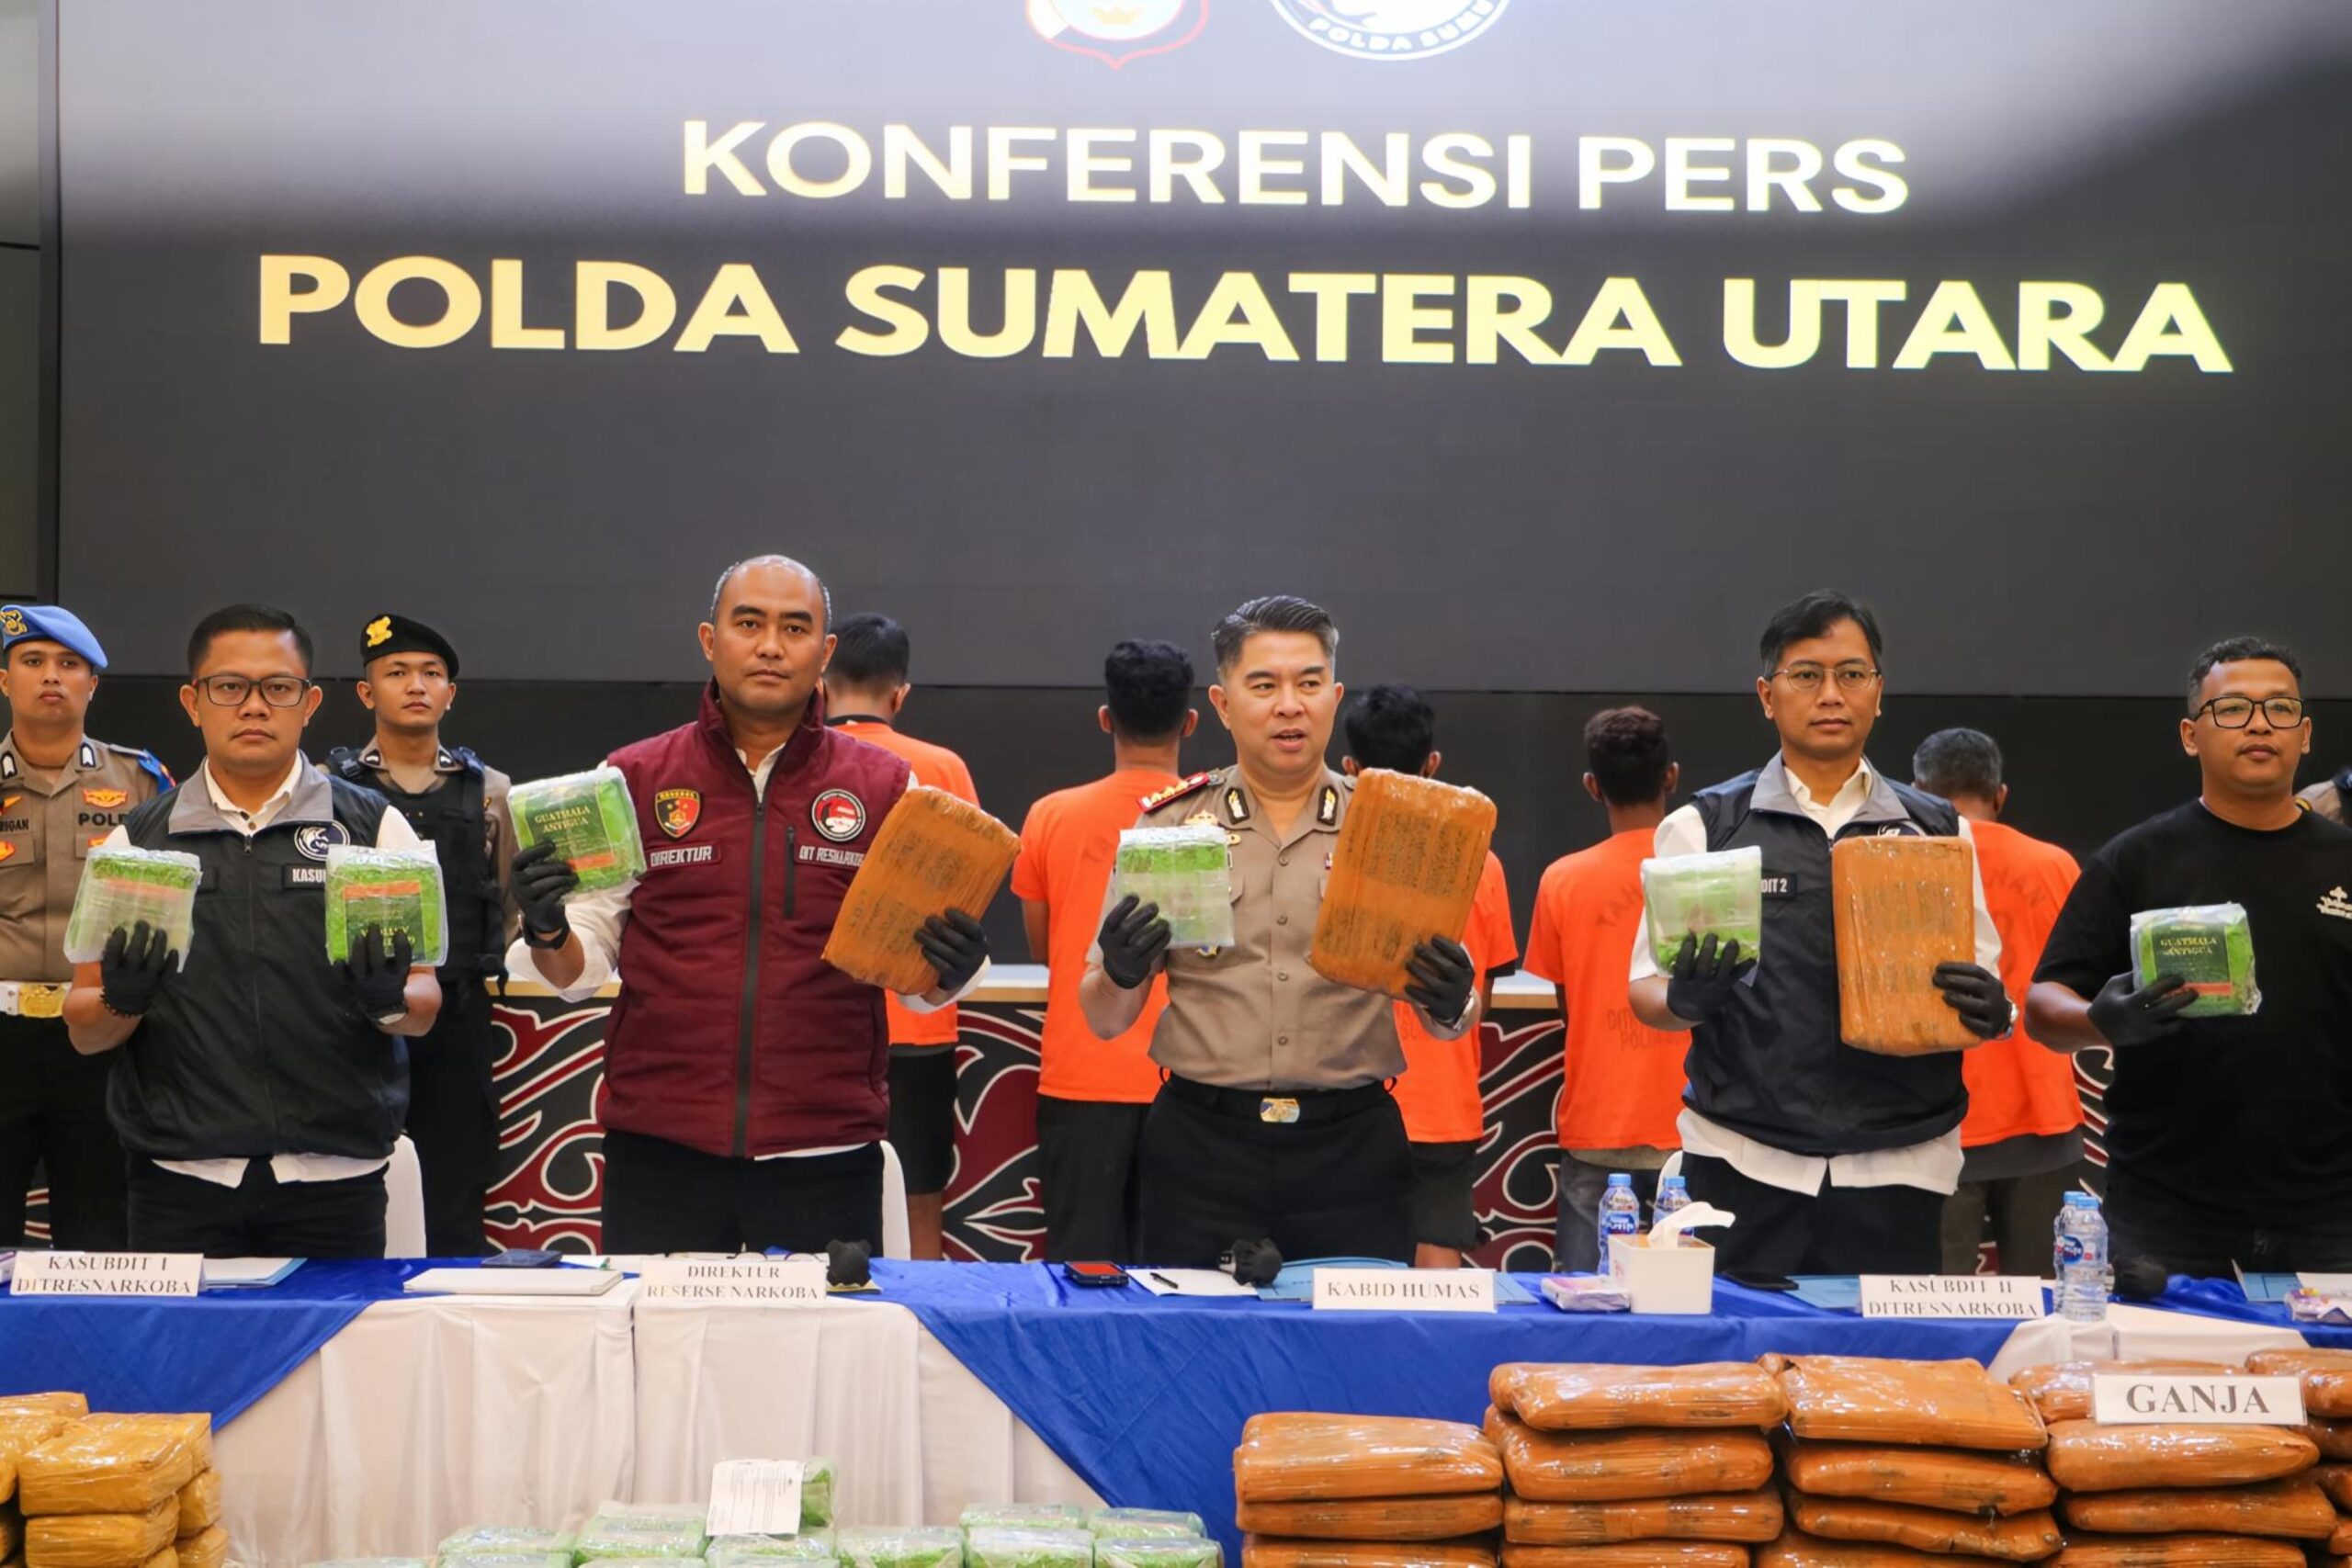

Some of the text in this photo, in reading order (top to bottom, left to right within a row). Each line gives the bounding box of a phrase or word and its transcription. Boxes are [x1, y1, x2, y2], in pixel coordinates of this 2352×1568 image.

[1307, 17, 1412, 51] POLDA
[684, 120, 1909, 214] KONFERENSI PERS
[259, 255, 2234, 373] POLDA SUMATERA UTARA
[650, 845, 712, 867] DIREKTUR
[1761, 877, 1788, 893] DIT 2
[48, 1256, 150, 1271] KASUBDIT
[687, 1265, 780, 1279] DIREKTUR
[16, 1278, 191, 1294] DITRESNARKOBA
[647, 1284, 818, 1299] RESERSE NARKOBA
[1328, 1282, 1480, 1299] KABID HUMAS
[1890, 1279, 1986, 1293] KASUBDIT
[1869, 1302, 2039, 1317] DITRESNARKOBA
[2126, 1384, 2270, 1414] GANJA
